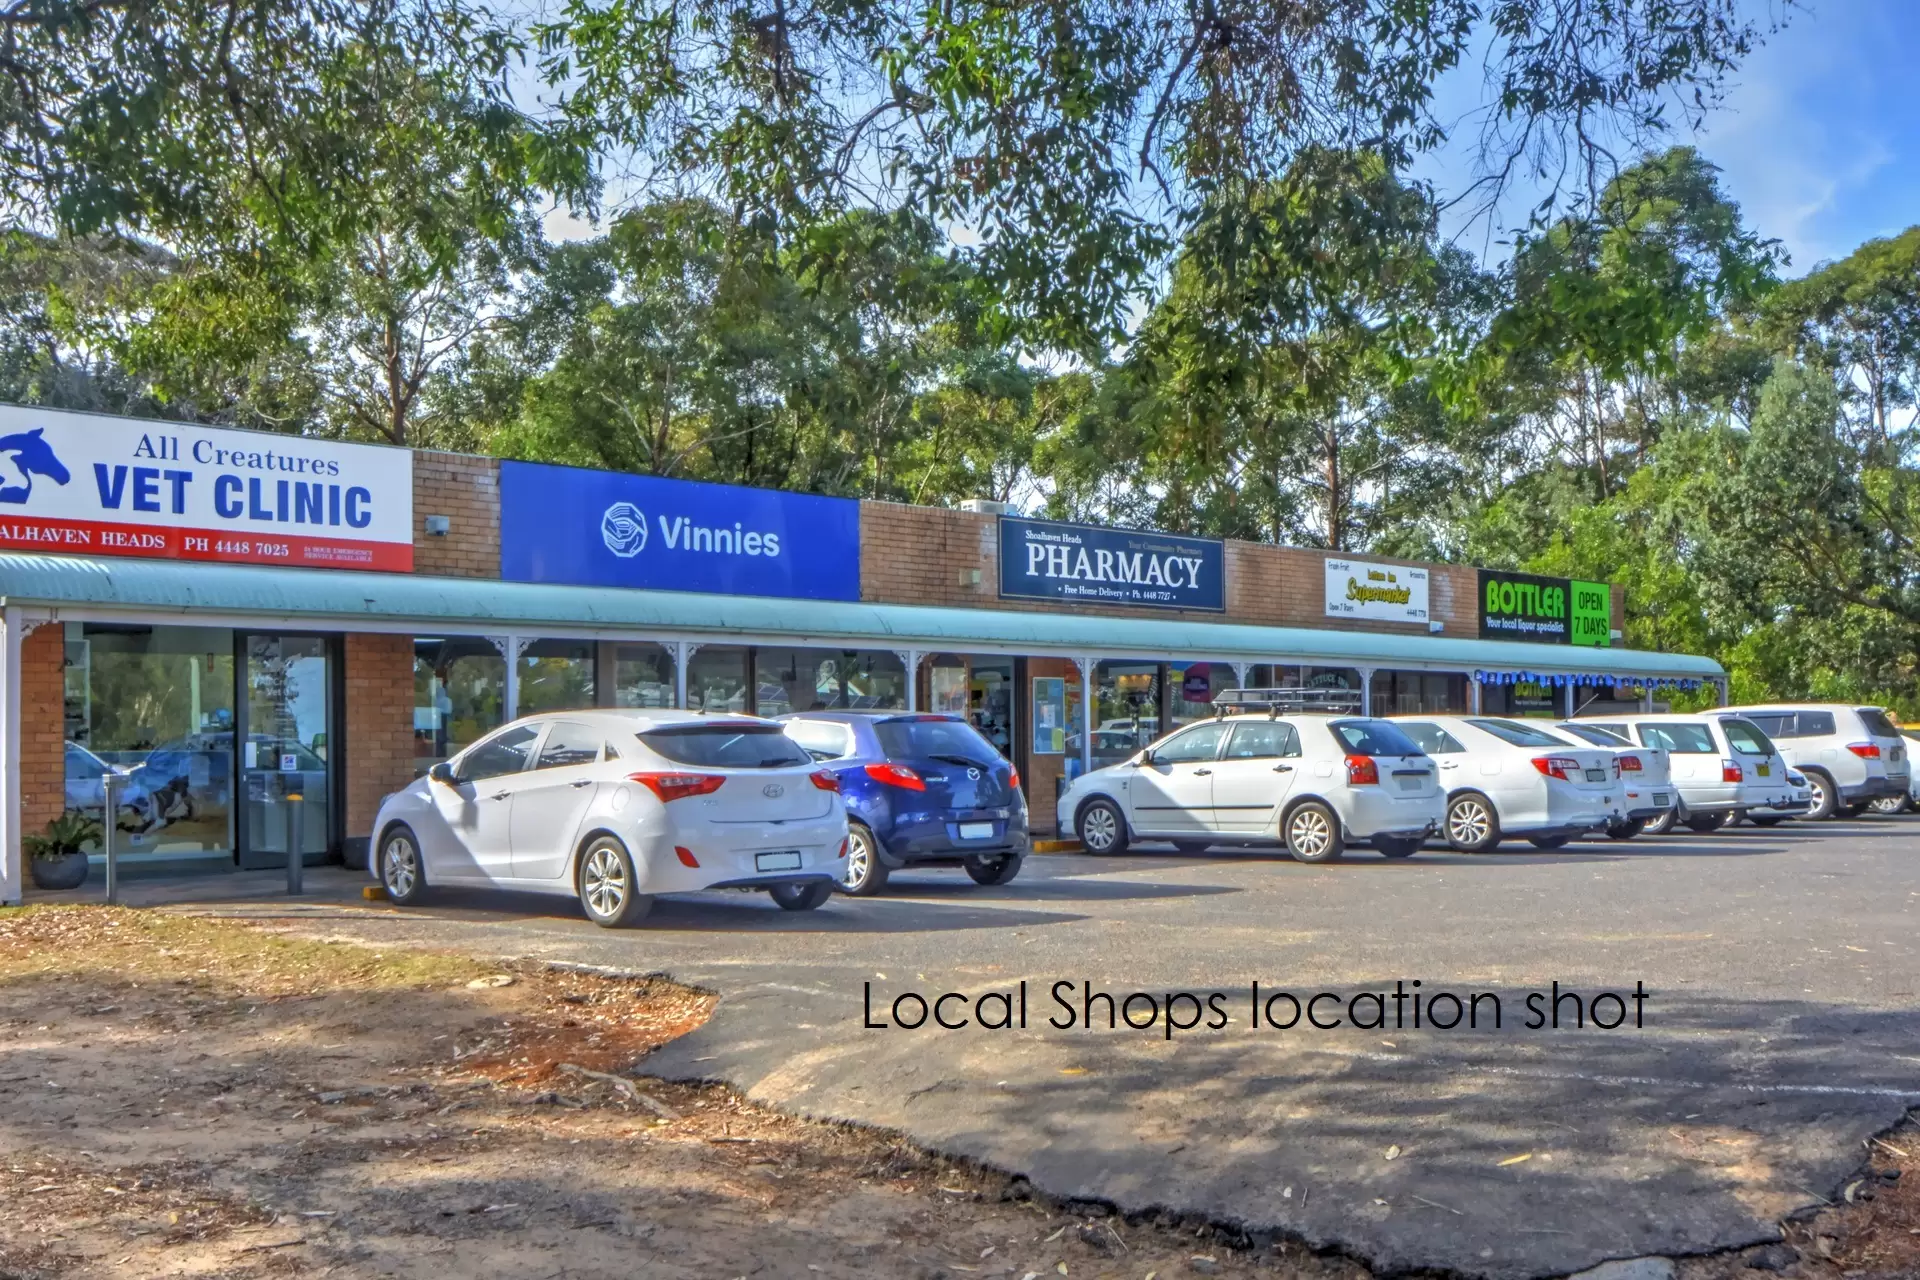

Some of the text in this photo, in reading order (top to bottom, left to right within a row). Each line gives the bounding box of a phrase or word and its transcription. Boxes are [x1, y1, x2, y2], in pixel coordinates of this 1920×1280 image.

[133, 433, 340, 476] All Creatures
[93, 462, 372, 528] VET CLINIC
[0, 525, 289, 557] ALHAVEN HEADS PH 4448 7025
[658, 514, 780, 557] Vinnies
[1025, 530, 1082, 544] Shoalhaven Heads
[1025, 543, 1203, 588] PHARMACY
[1064, 584, 1078, 594] Free
[1079, 586, 1097, 596] Home
[1099, 587, 1123, 599] Delivery
[1143, 590, 1157, 600] 4448
[1345, 577, 1411, 606] Supermarket
[1486, 579, 1565, 619] BOTTLER
[1578, 591, 1603, 611] OPEN
[1486, 616, 1564, 634] Your local liquor specialist
[1574, 617, 1607, 636] 7 DAYS
